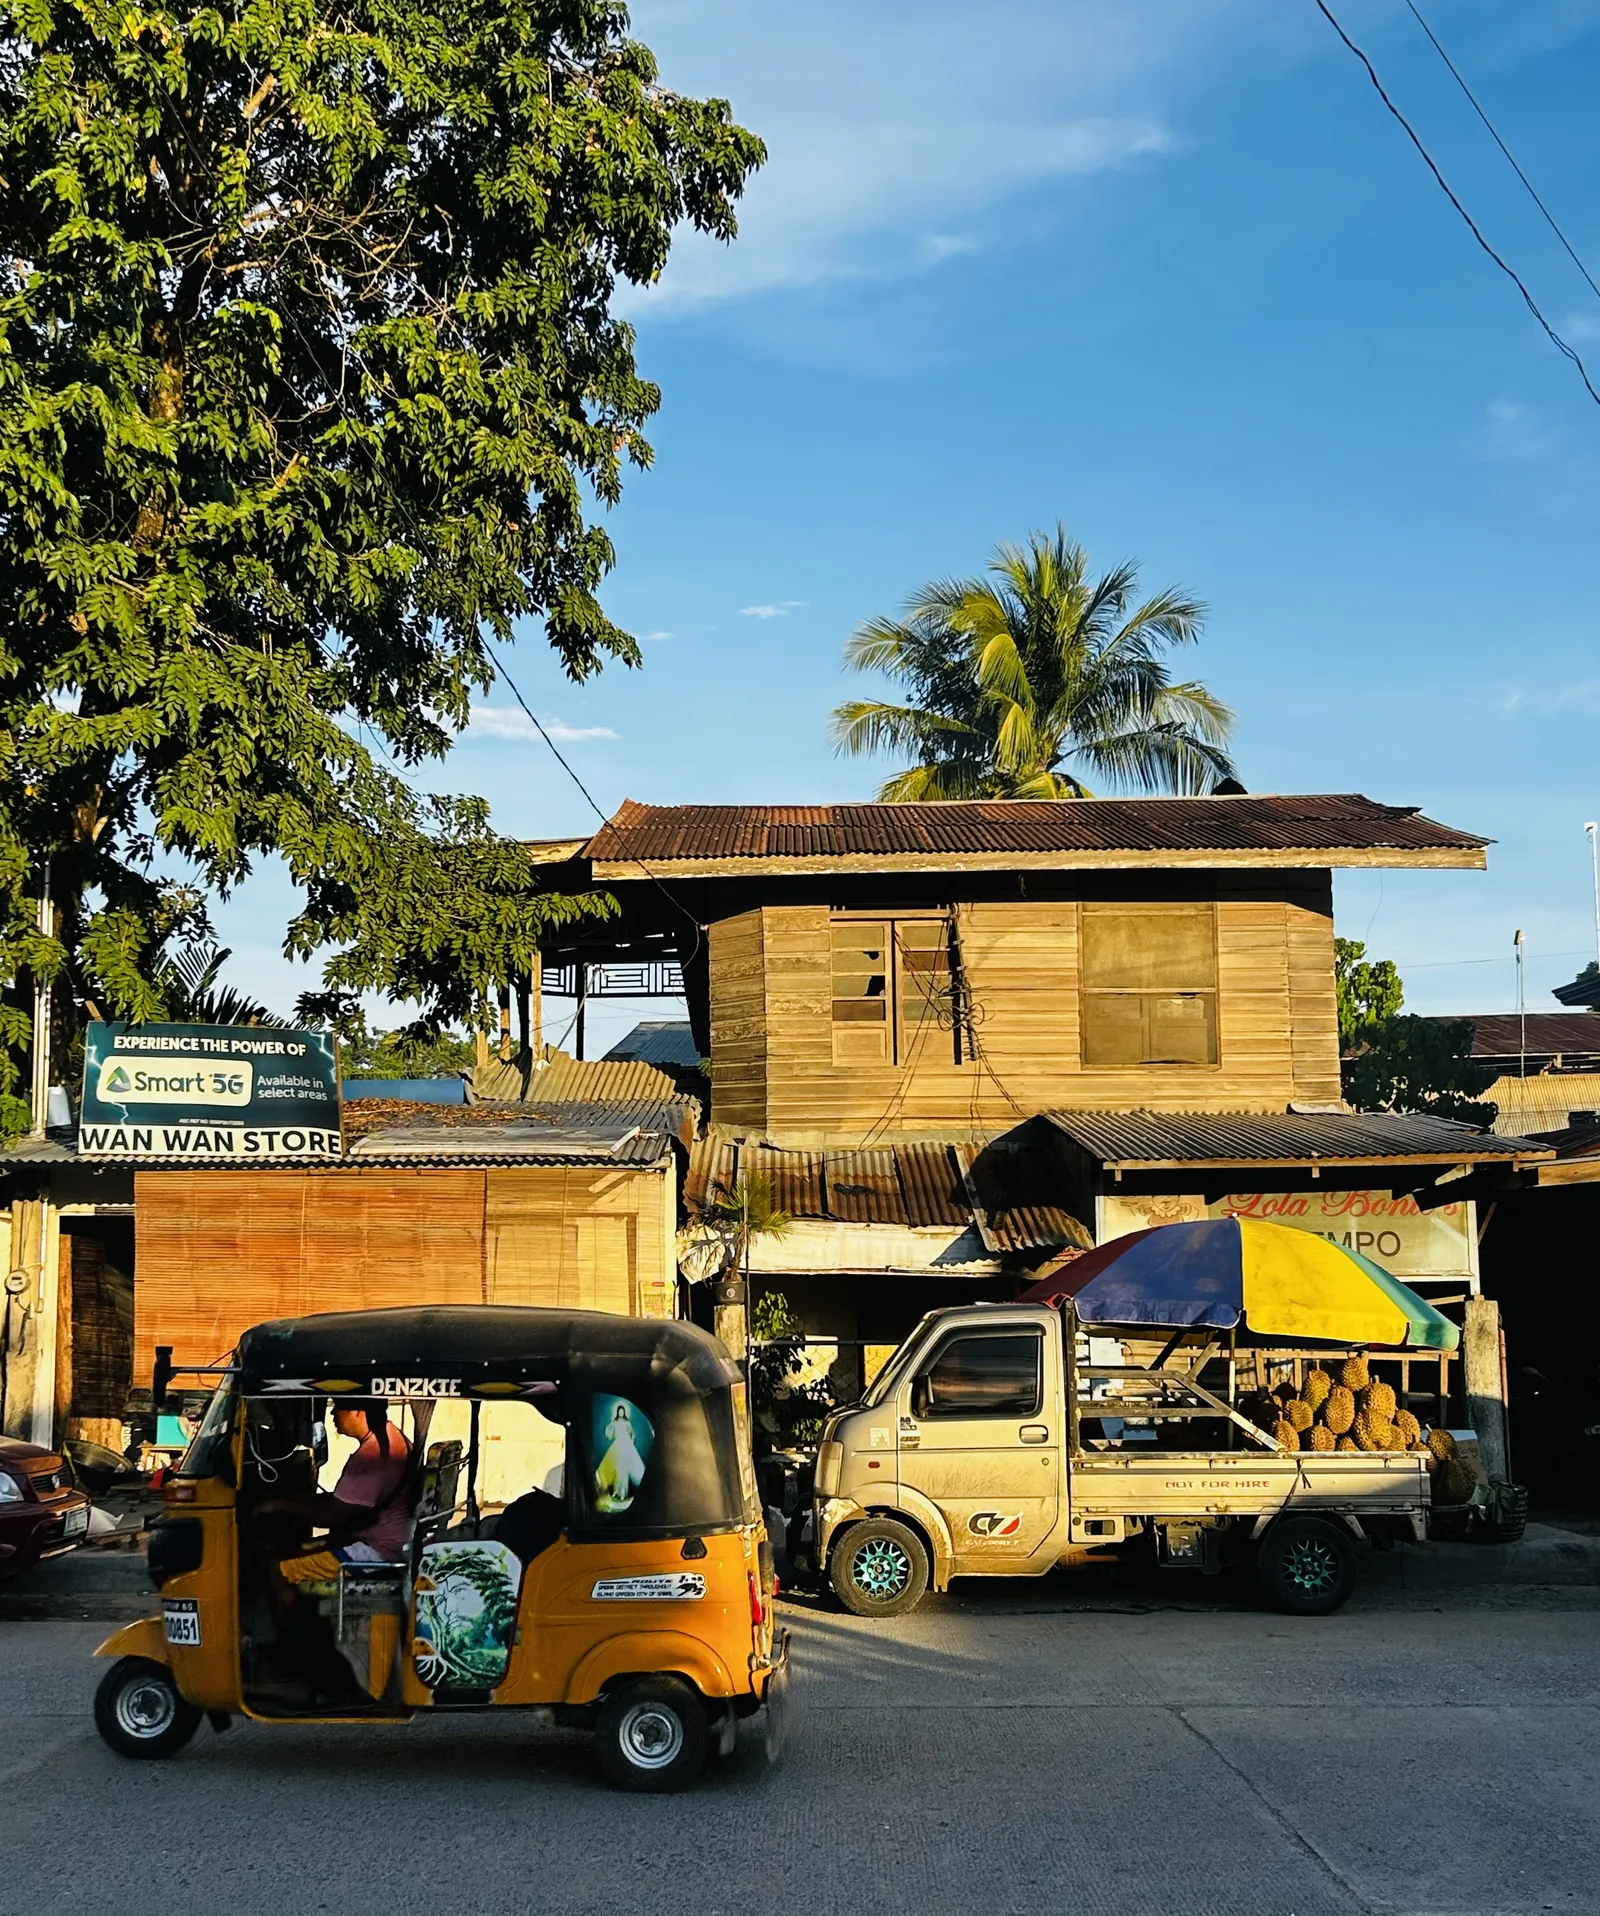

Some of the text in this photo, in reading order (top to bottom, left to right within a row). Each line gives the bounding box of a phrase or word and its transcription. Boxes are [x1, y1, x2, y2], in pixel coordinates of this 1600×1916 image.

[114, 1036, 307, 1057] EXPERIENCE THE POWER OF
[135, 1071, 244, 1095] Smart 5G
[257, 1075, 324, 1089] Available in
[258, 1087, 328, 1101] select areas
[81, 1128, 341, 1155] WAN WAN STORE
[1220, 1193, 1311, 1219] Lola
[371, 1378, 462, 1396] DENZKIE
[1235, 1480, 1271, 1488] HIRE
